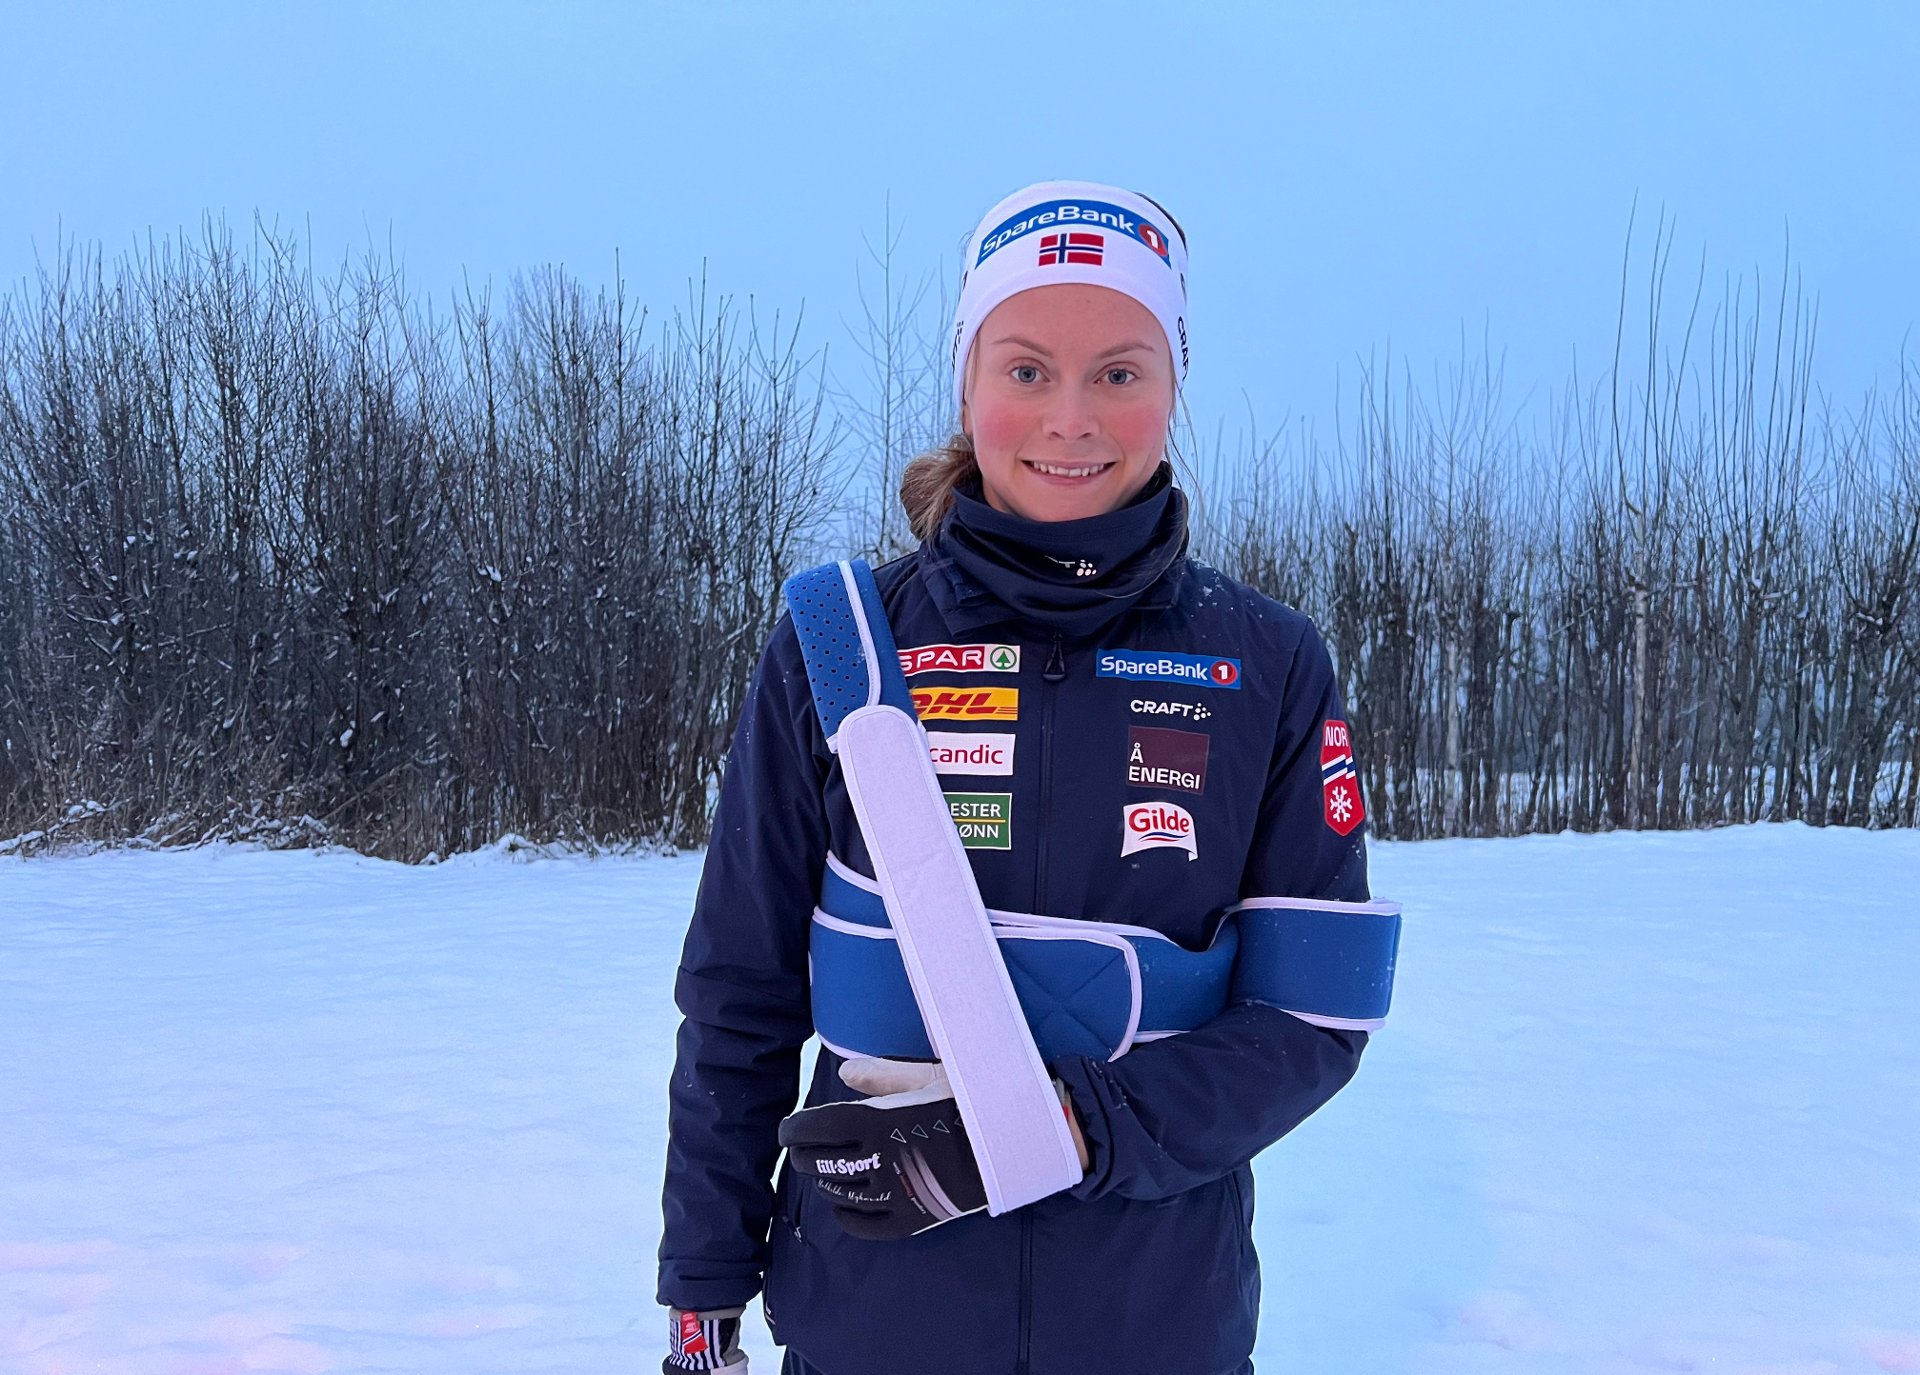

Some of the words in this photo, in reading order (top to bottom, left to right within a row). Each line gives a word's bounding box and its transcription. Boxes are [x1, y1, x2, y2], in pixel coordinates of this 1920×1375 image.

[981, 206, 1135, 257] SpareBank
[1146, 230, 1159, 249] 1
[898, 650, 982, 671] SPAR
[1101, 656, 1208, 681] SpareBank
[1218, 665, 1228, 680] 1
[912, 692, 999, 715] DHL
[1130, 700, 1193, 717] CRAFT
[1325, 726, 1349, 747] NOR
[930, 744, 1003, 764] candic
[1130, 742, 1144, 763] Å
[1128, 766, 1200, 790] ENERGI
[950, 803, 1001, 818] ESTER
[1128, 808, 1190, 833] Gilde
[958, 823, 999, 839] ØNN
